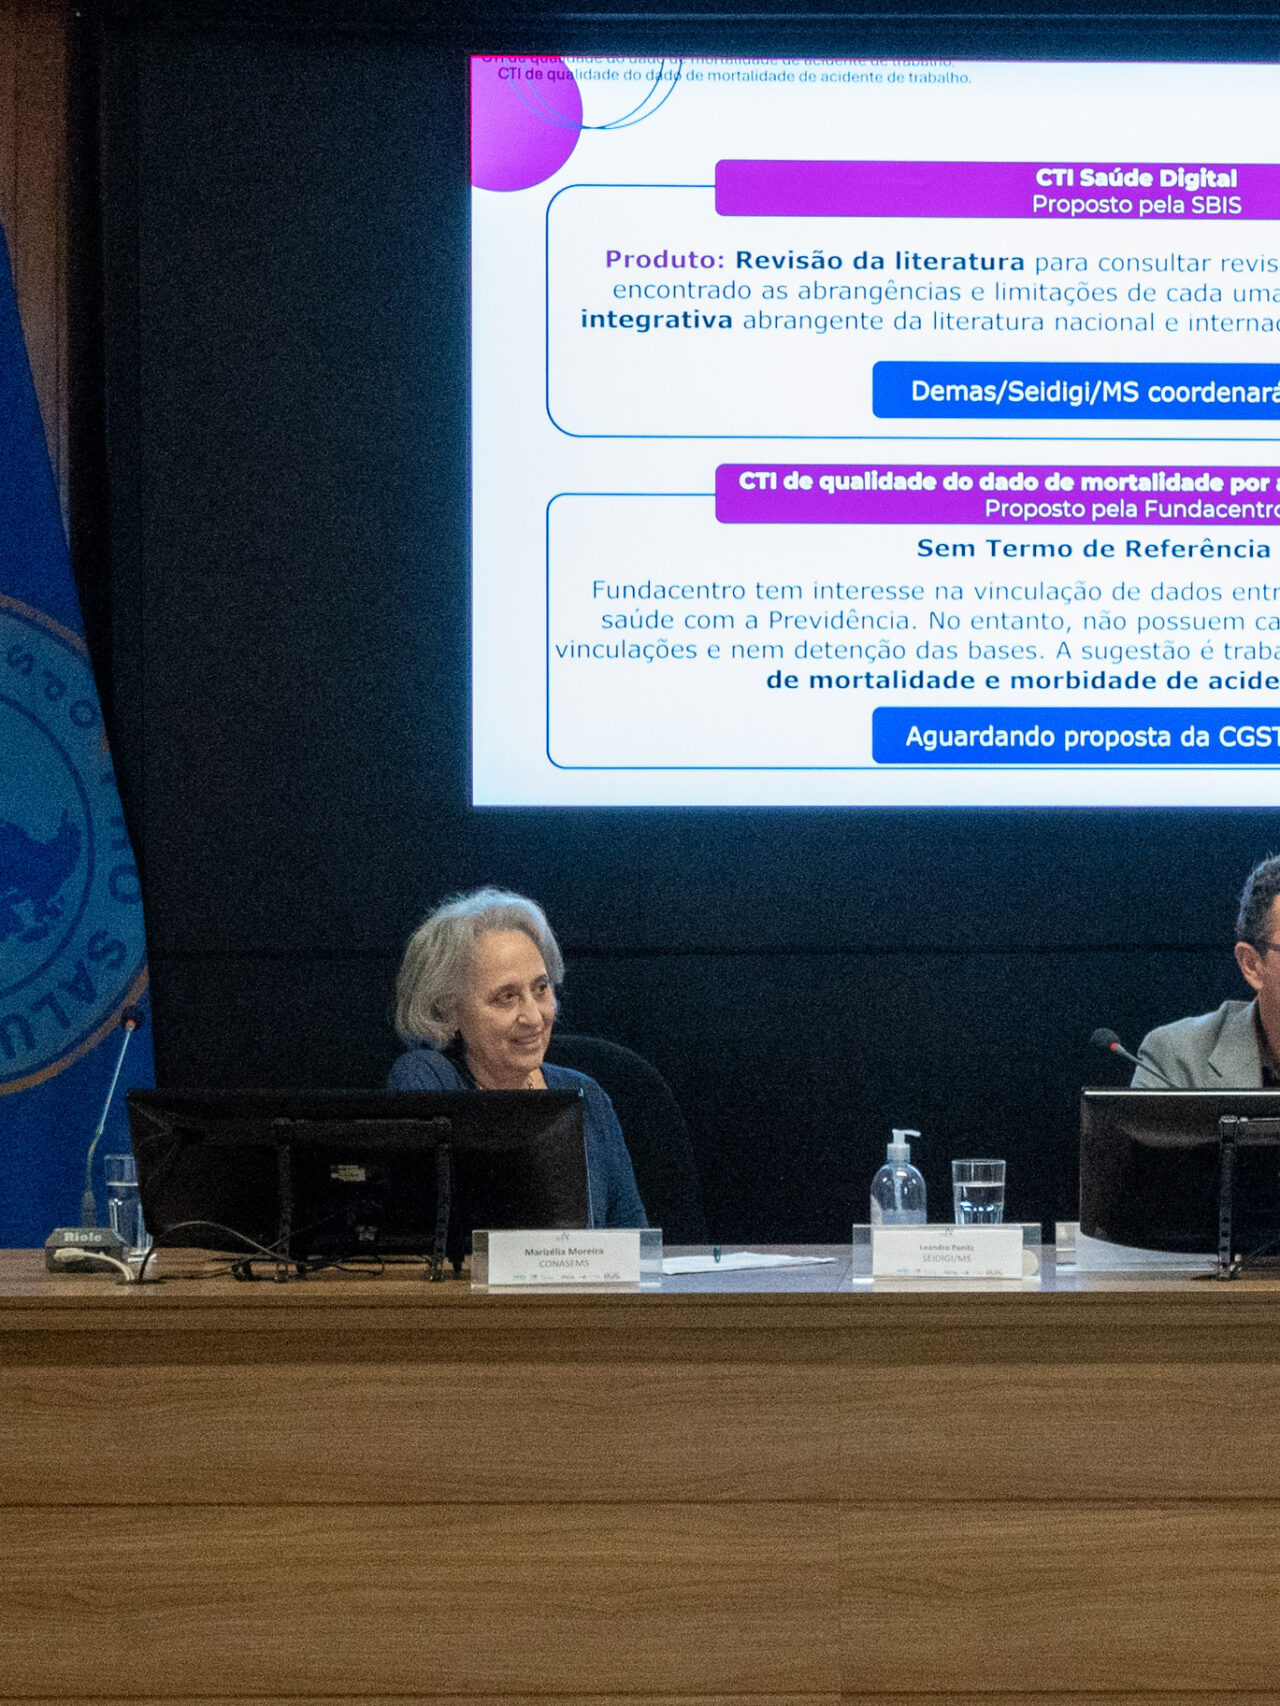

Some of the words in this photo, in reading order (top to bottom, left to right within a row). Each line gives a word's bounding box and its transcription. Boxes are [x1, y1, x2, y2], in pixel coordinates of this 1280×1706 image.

[1035, 168, 1074, 188] CTI
[1079, 167, 1154, 189] Saúde
[1159, 167, 1238, 193] Digital
[1032, 194, 1133, 219] Proposto
[1139, 195, 1185, 219] pela
[1191, 196, 1243, 216] SBIS
[606, 250, 724, 271] Produto:
[736, 250, 844, 272] Revisão
[852, 251, 885, 272] da
[895, 251, 1025, 273] literatura
[1035, 257, 1088, 277] para
[1098, 253, 1212, 274] consultar
[612, 280, 752, 302] encontrado
[761, 285, 789, 302] as
[797, 280, 961, 307] abrangências
[971, 287, 985, 303] e
[995, 282, 1118, 308] limitações
[1127, 283, 1157, 304] de
[1166, 283, 1222, 304] cada
[581, 309, 733, 335] integrativa
[743, 310, 884, 336] abrangente
[893, 311, 922, 332] da
[933, 311, 1044, 333] literatura
[1055, 312, 1155, 333] nacional
[1164, 318, 1179, 334] e
[912, 380, 1140, 408] Demas/Seidigi/MS
[738, 471, 778, 492] CTI
[782, 471, 814, 492] de
[818, 470, 938, 496] qualidade
[942, 472, 974, 493] do
[978, 472, 1040, 493] dado
[1044, 472, 1075, 493] de
[1080, 471, 1225, 494] mortalidade
[1229, 477, 1271, 498] por
[985, 499, 1086, 523] Proposto
[1091, 499, 1138, 523] pela
[917, 539, 975, 559] Sem
[985, 539, 1073, 559] Termo
[1082, 539, 1115, 560] de
[1125, 538, 1271, 560] Referência
[592, 579, 746, 602] Fundacentro
[755, 582, 803, 602] tem
[813, 581, 925, 602] interesse
[935, 586, 964, 602] na
[973, 581, 1102, 607] vinculação
[1111, 581, 1141, 603] de
[1150, 582, 1223, 603] dados
[601, 609, 675, 631] saúde
[684, 615, 735, 631] com
[744, 615, 758, 632] a
[769, 609, 917, 632] Previdência.
[929, 611, 961, 632] No
[970, 612, 1072, 635] entanto,
[1083, 610, 1127, 632] não
[1137, 616, 1245, 636] possuem
[555, 639, 698, 665] vinculações
[706, 644, 721, 661] e
[731, 645, 784, 661] nem
[794, 639, 906, 665] detenção
[915, 640, 958, 662] das
[968, 640, 1044, 662] bases.
[1055, 641, 1072, 661] A
[1081, 640, 1191, 666] sugestão
[1200, 640, 1214, 662] é
[766, 670, 799, 691] de
[809, 670, 976, 691] mortalidade
[984, 675, 1000, 691] e
[1010, 670, 1157, 691] morbidade
[1166, 671, 1199, 691] de
[905, 725, 1056, 753] Aguardando
[1064, 727, 1172, 753] proposta
[1180, 725, 1210, 749] da
[568, 1248, 605, 1256] Moreira
